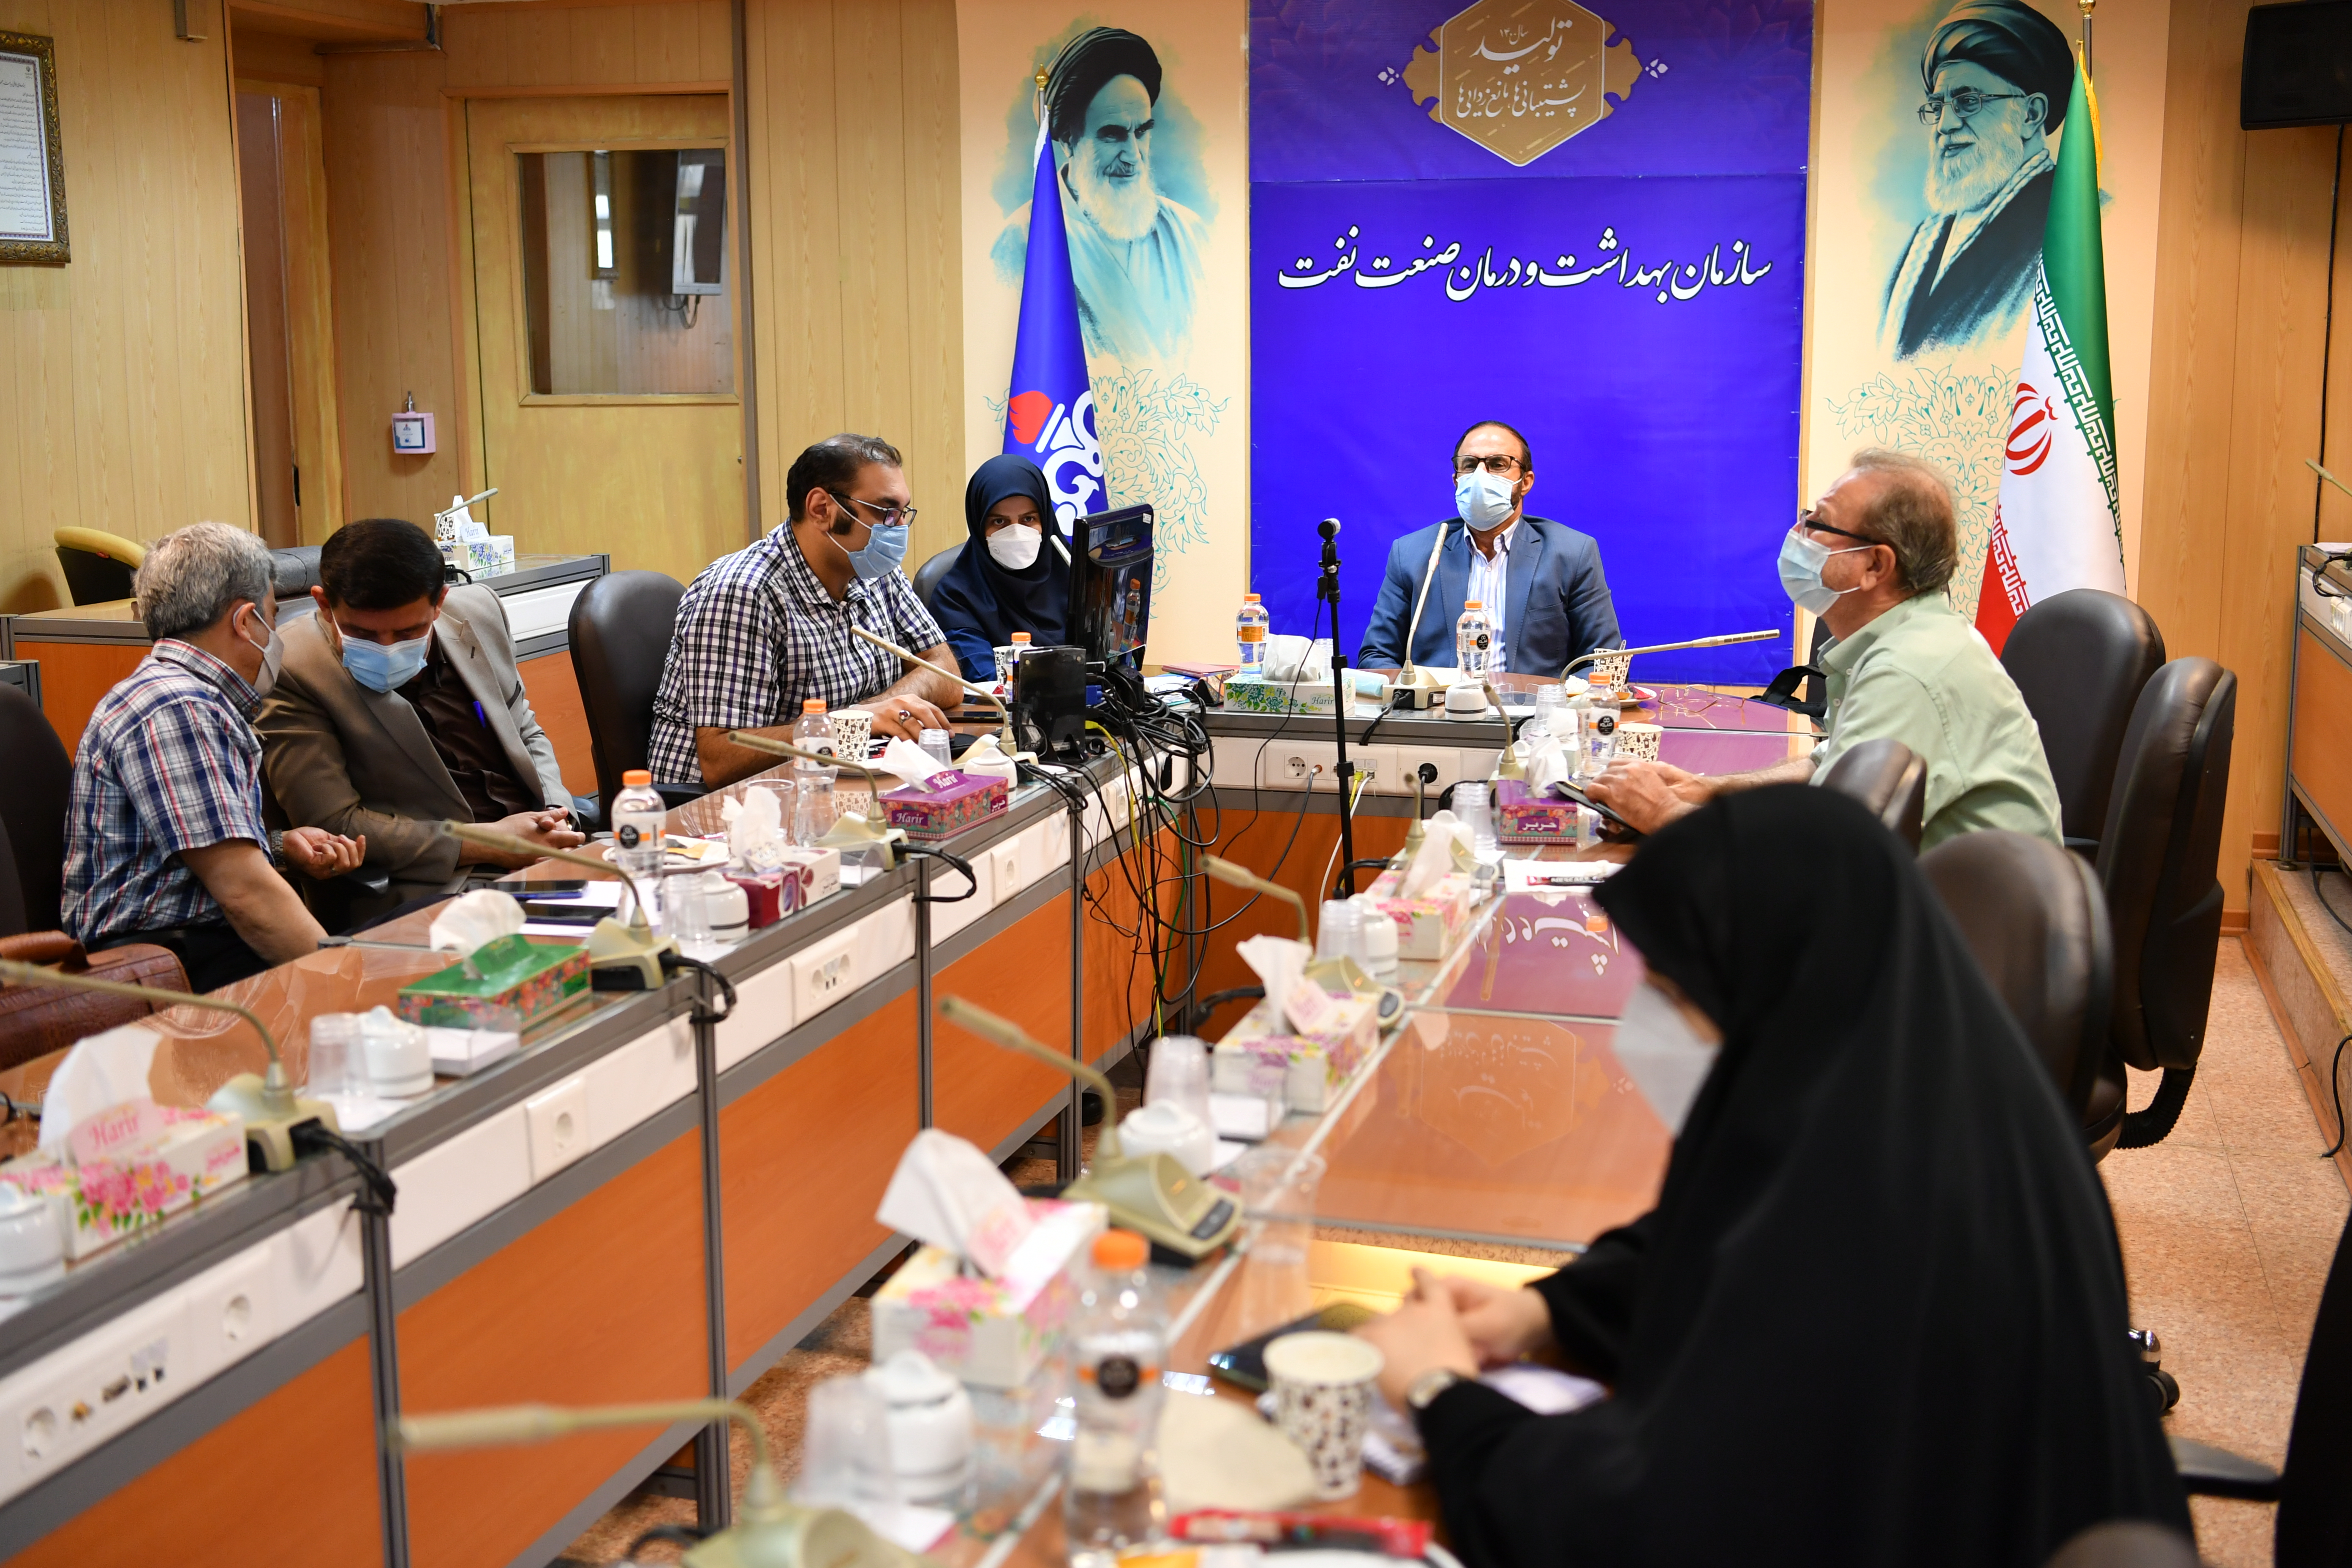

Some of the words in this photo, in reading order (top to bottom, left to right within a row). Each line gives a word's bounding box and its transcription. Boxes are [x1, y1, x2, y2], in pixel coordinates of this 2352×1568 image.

[1469, 15, 1573, 75] تولید
[1278, 225, 1359, 289] نفت
[1355, 235, 1461, 288] صنعت
[1445, 247, 1521, 302] درمان
[1522, 261, 1538, 287] و
[1538, 227, 1672, 304] بهداشت
[1670, 240, 1772, 300] سازمان
[465, 525, 479, 537] Harir
[1311, 696, 1334, 705] Harir
[932, 773, 958, 789] Harir
[896, 812, 924, 825] Harir
[1522, 822, 1557, 831] حریر
